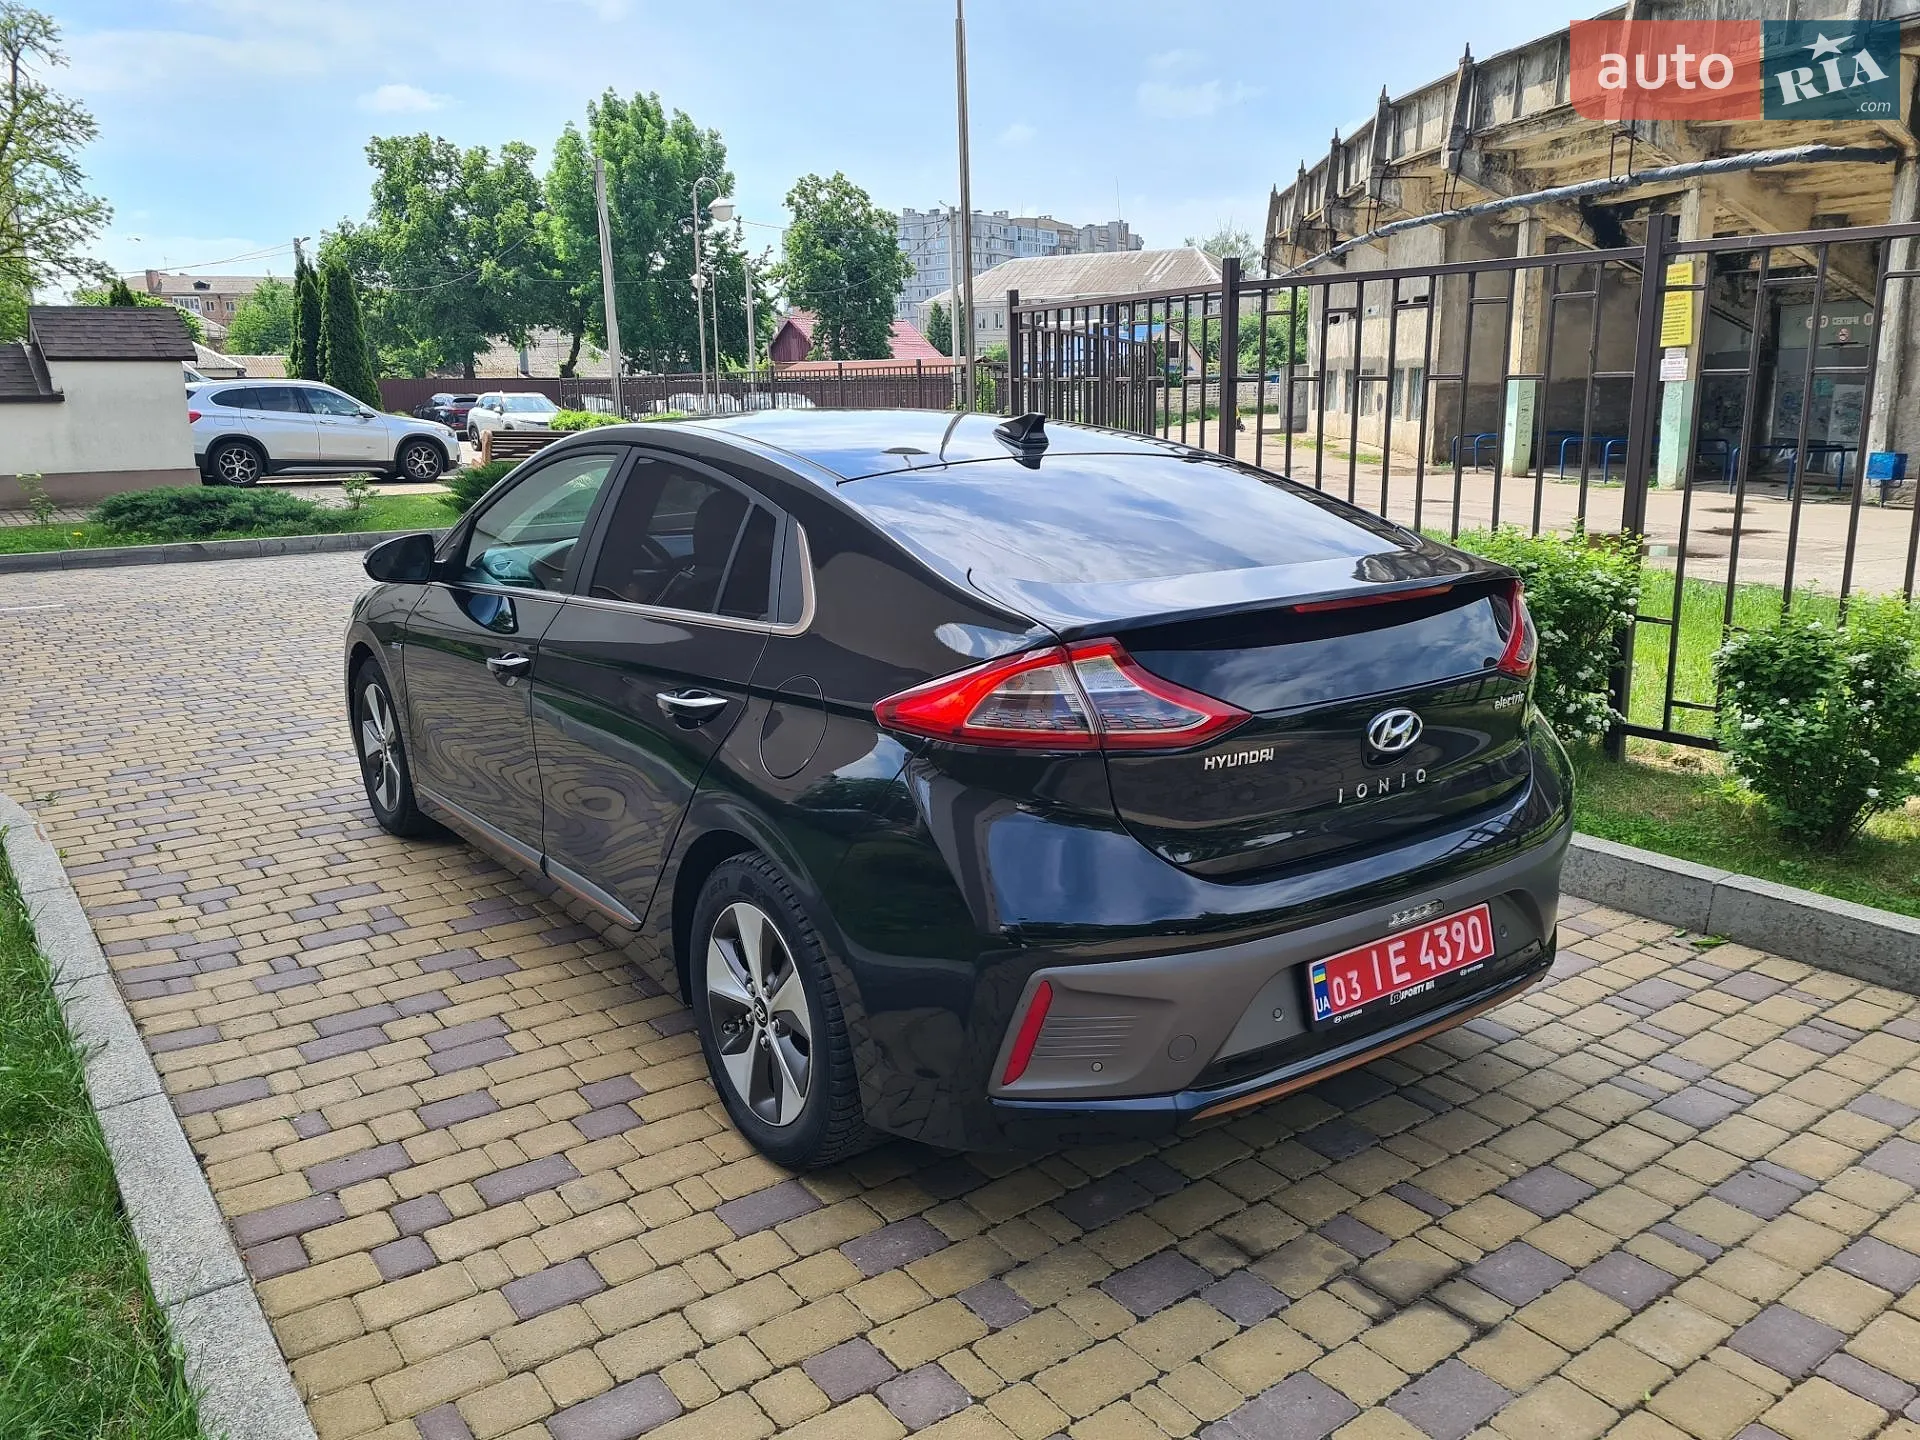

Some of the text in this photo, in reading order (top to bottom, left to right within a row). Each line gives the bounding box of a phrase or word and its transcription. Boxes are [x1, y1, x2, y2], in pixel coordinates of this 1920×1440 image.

[1494, 690, 1526, 711] electric
[1203, 747, 1275, 771] HYUNDAI
[1336, 768, 1428, 804] IONIQ
[1332, 915, 1484, 1007] 03 IE 4390
[1316, 997, 1331, 1014] UA
